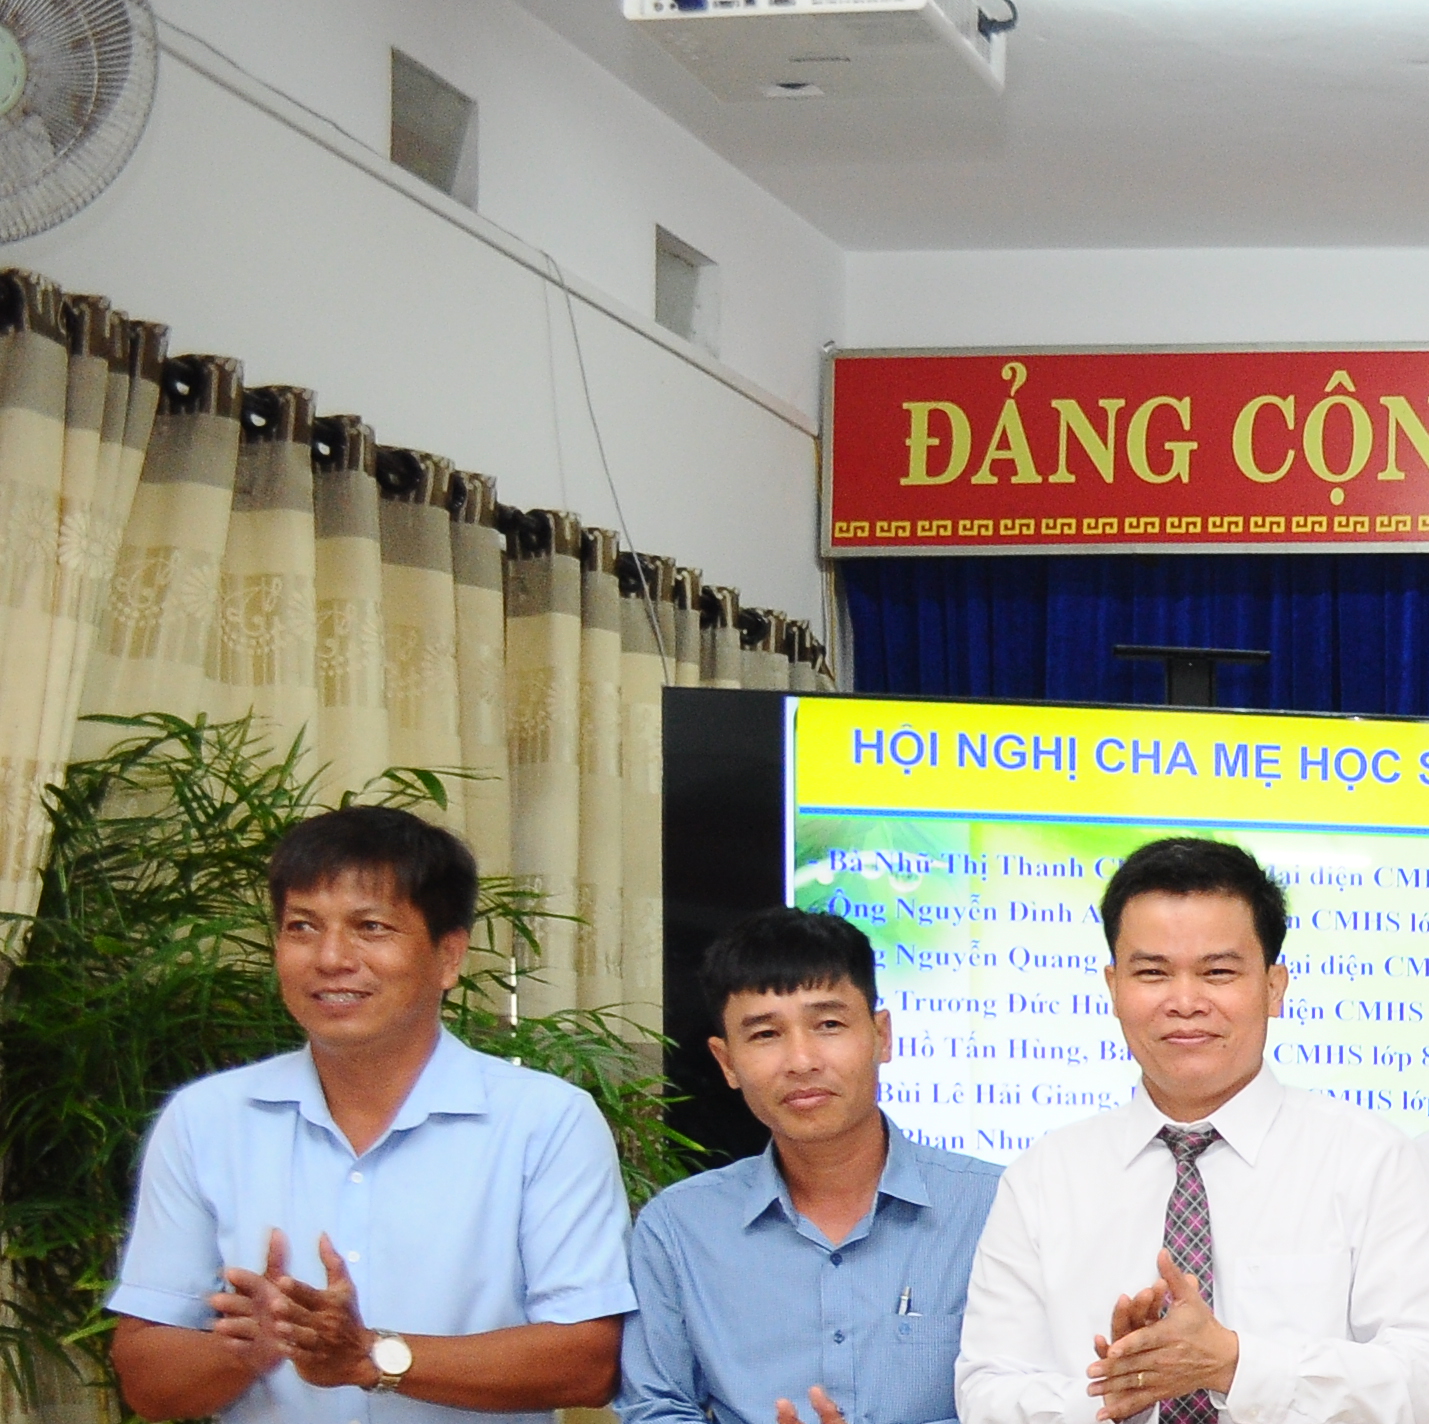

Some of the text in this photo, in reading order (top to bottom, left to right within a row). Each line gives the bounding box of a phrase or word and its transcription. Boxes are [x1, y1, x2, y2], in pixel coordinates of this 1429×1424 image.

[900, 361, 1196, 486] ĐẢNG
[853, 724, 938, 775] HỘI
[958, 732, 1077, 781] NGHỊ
[1095, 738, 1198, 776] CHA
[1214, 742, 1281, 788] MẸ
[1300, 745, 1401, 791] HỌC
[941, 852, 987, 881] Thị
[996, 854, 1084, 878] Thanh
[1310, 865, 1363, 892] diện
[828, 888, 887, 925] Ông
[896, 893, 998, 926] Nguyễn
[1311, 908, 1400, 933] CMHS
[896, 939, 998, 972] Nguyễn
[1008, 945, 1098, 975] Quang
[1320, 954, 1374, 982] diện
[1334, 1000, 1424, 1023] CMHS
[897, 1029, 935, 1058] Hồ
[944, 1030, 997, 1059] Tấn
[1008, 1038, 1089, 1066] Hùng,
[1273, 1042, 1363, 1066] CMHS
[1373, 1045, 1412, 1073] lớp
[878, 1082, 921, 1104] Bùi
[931, 1082, 965, 1105] Lê
[1031, 1083, 1120, 1110] Giang,
